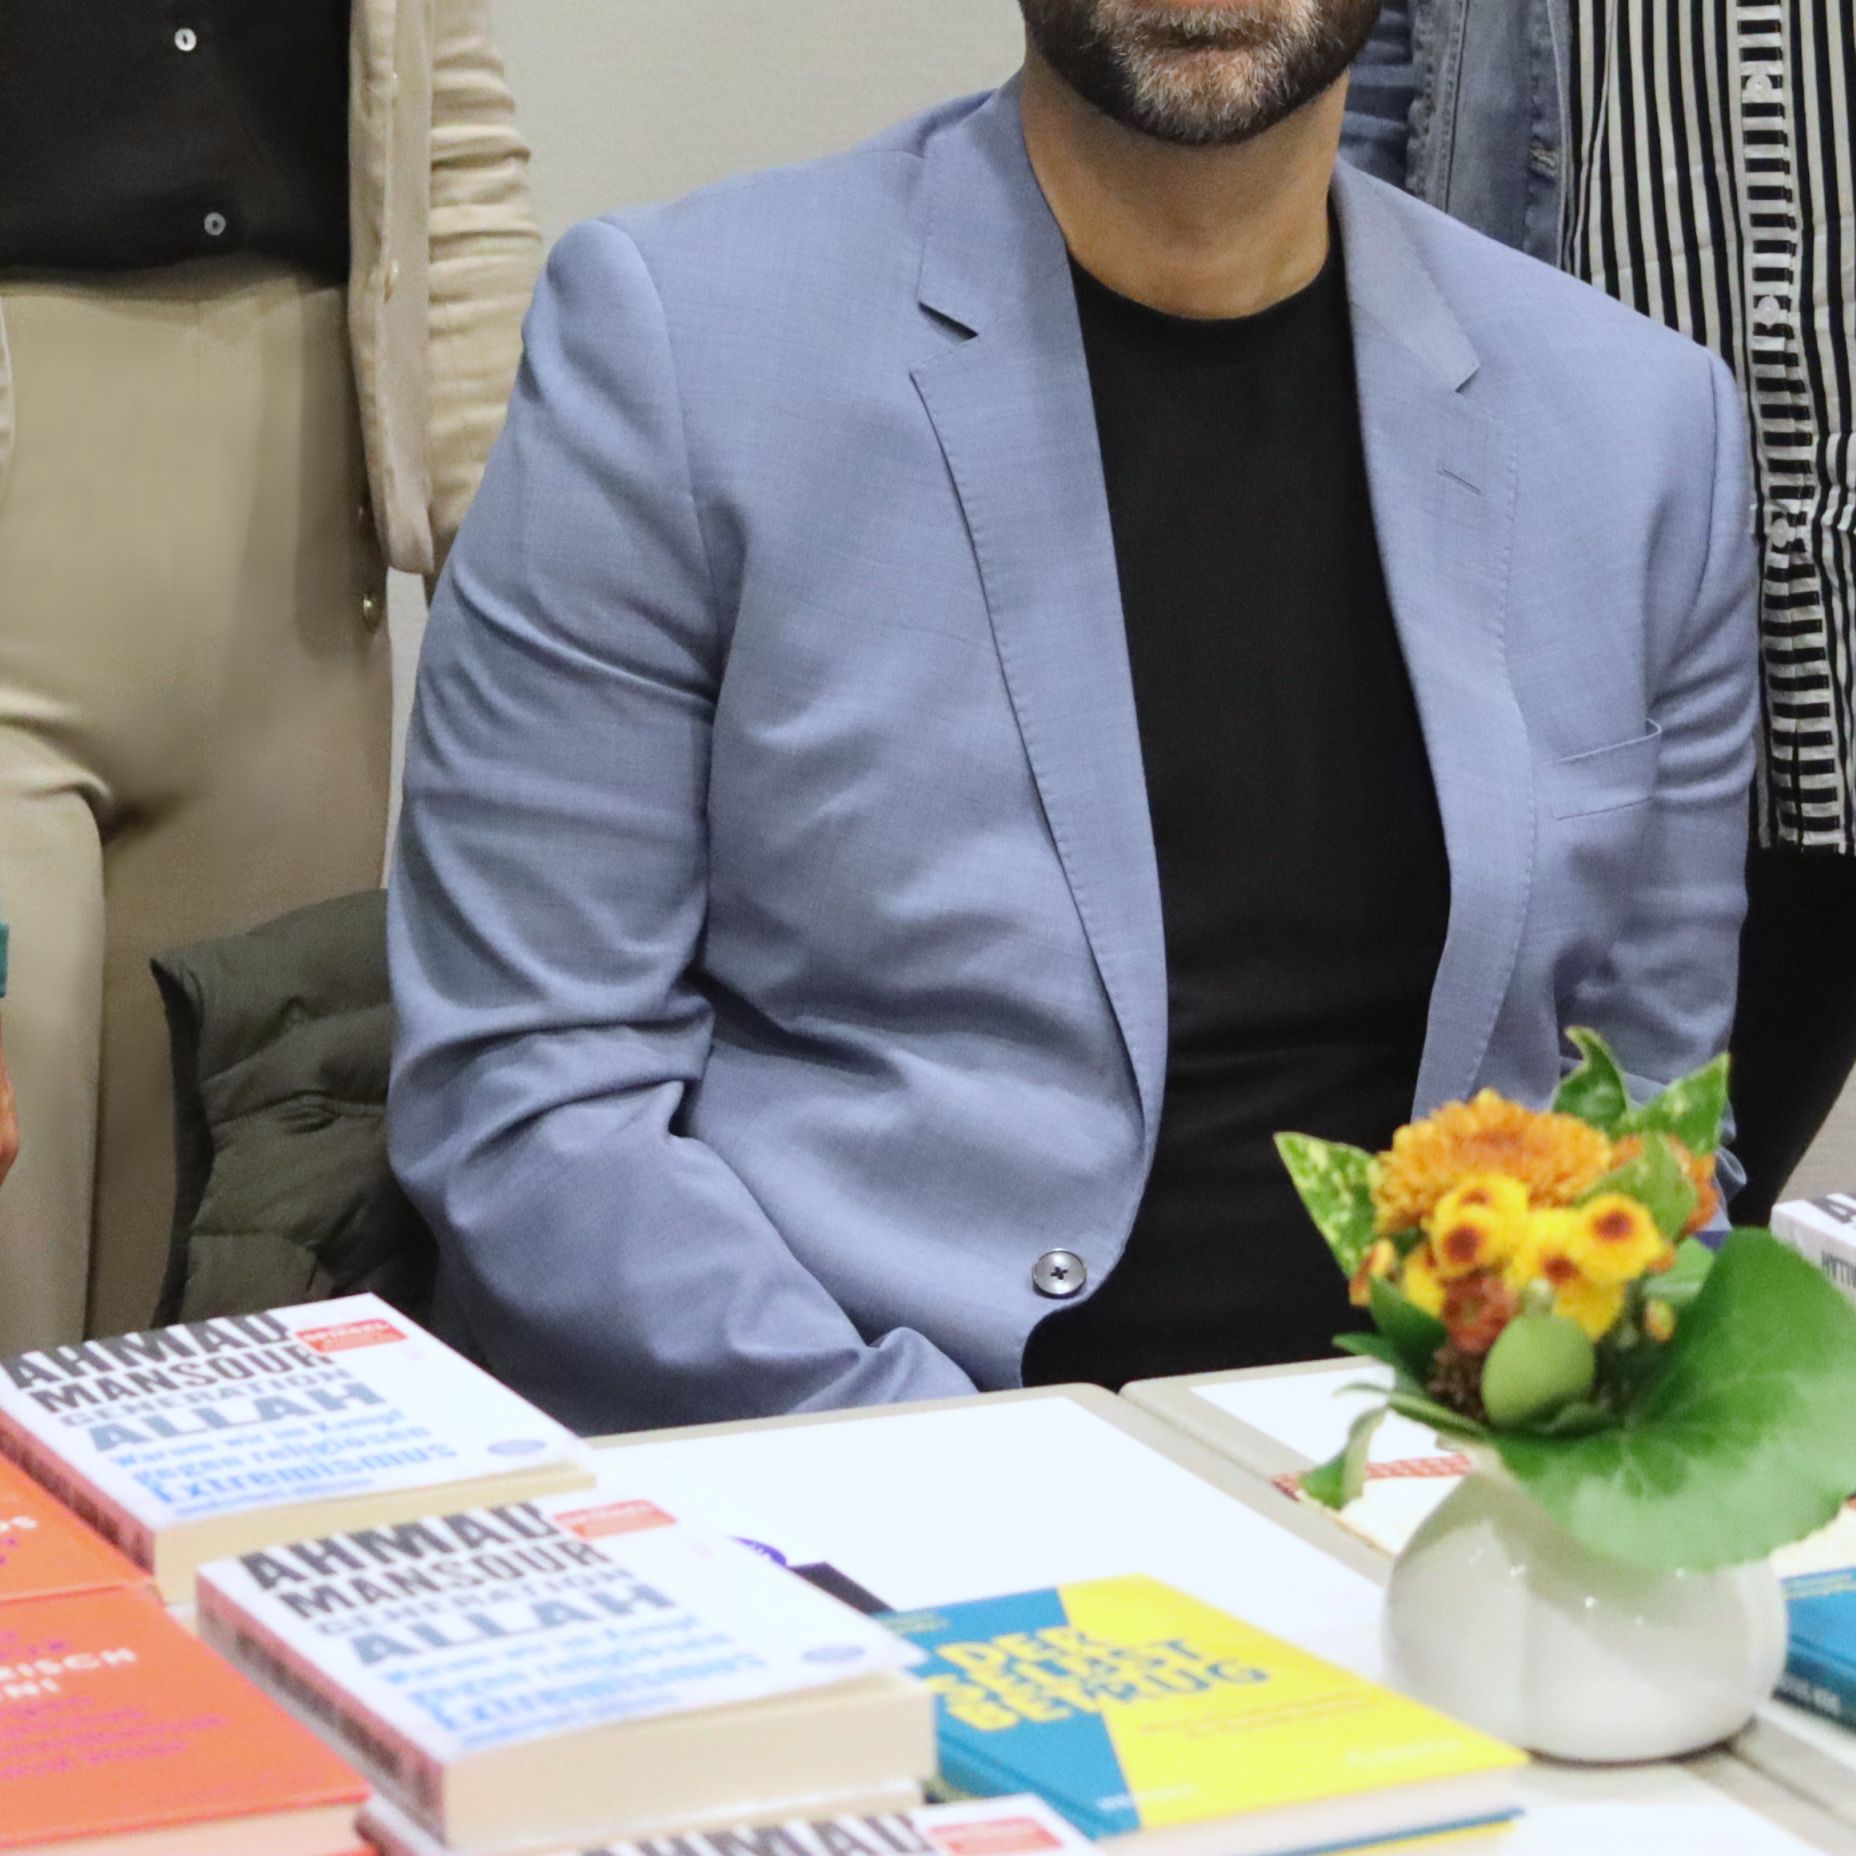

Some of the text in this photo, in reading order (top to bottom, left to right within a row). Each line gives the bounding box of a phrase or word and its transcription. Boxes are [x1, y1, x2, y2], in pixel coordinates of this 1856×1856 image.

[28, 1344, 336, 1414] MANSOUR
[58, 1365, 354, 1428] GENERATION
[87, 1382, 389, 1452] ALLAH
[240, 1501, 563, 1591] AHMAD
[277, 1541, 613, 1620] MANSOUR
[350, 1584, 679, 1667] ALLAH
